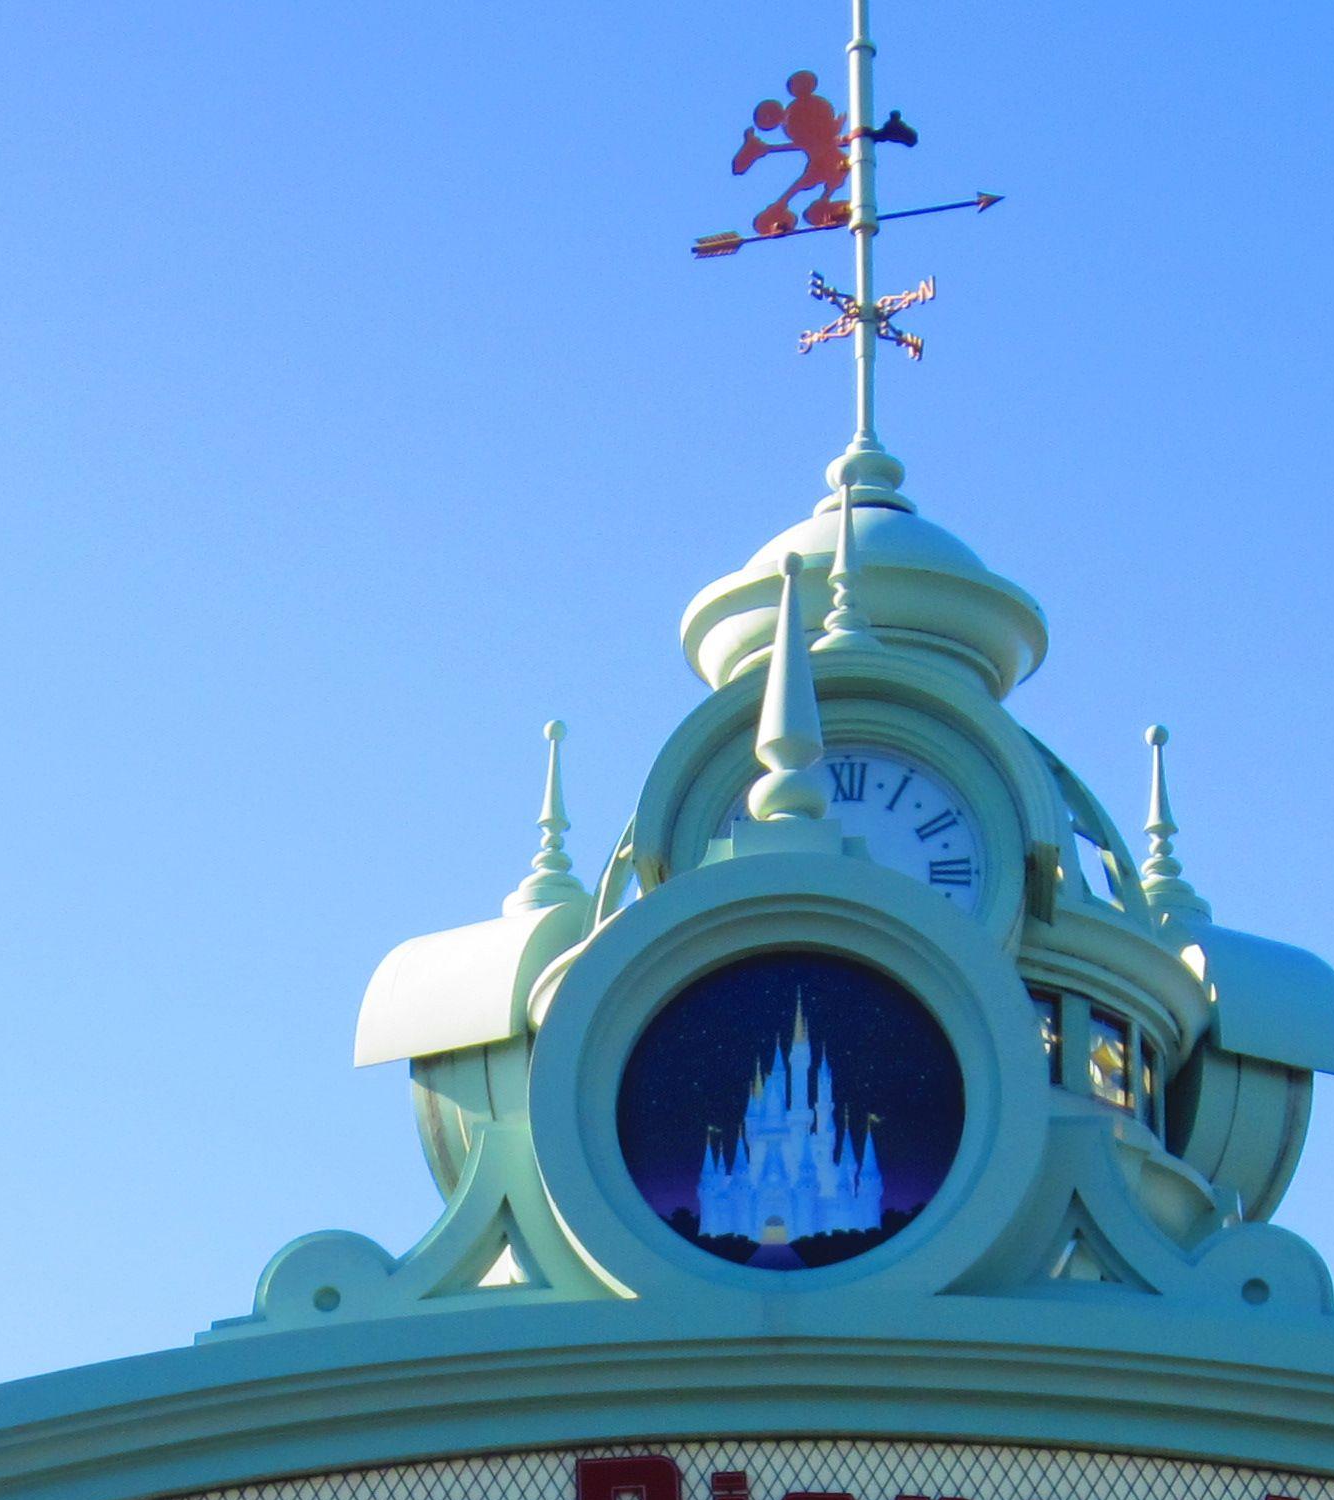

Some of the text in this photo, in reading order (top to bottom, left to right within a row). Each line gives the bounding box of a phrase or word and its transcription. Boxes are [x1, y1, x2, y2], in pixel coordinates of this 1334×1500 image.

[826, 762, 868, 803] XII
[885, 774, 912, 812] I
[915, 808, 959, 843] II
[928, 856, 972, 888] III
